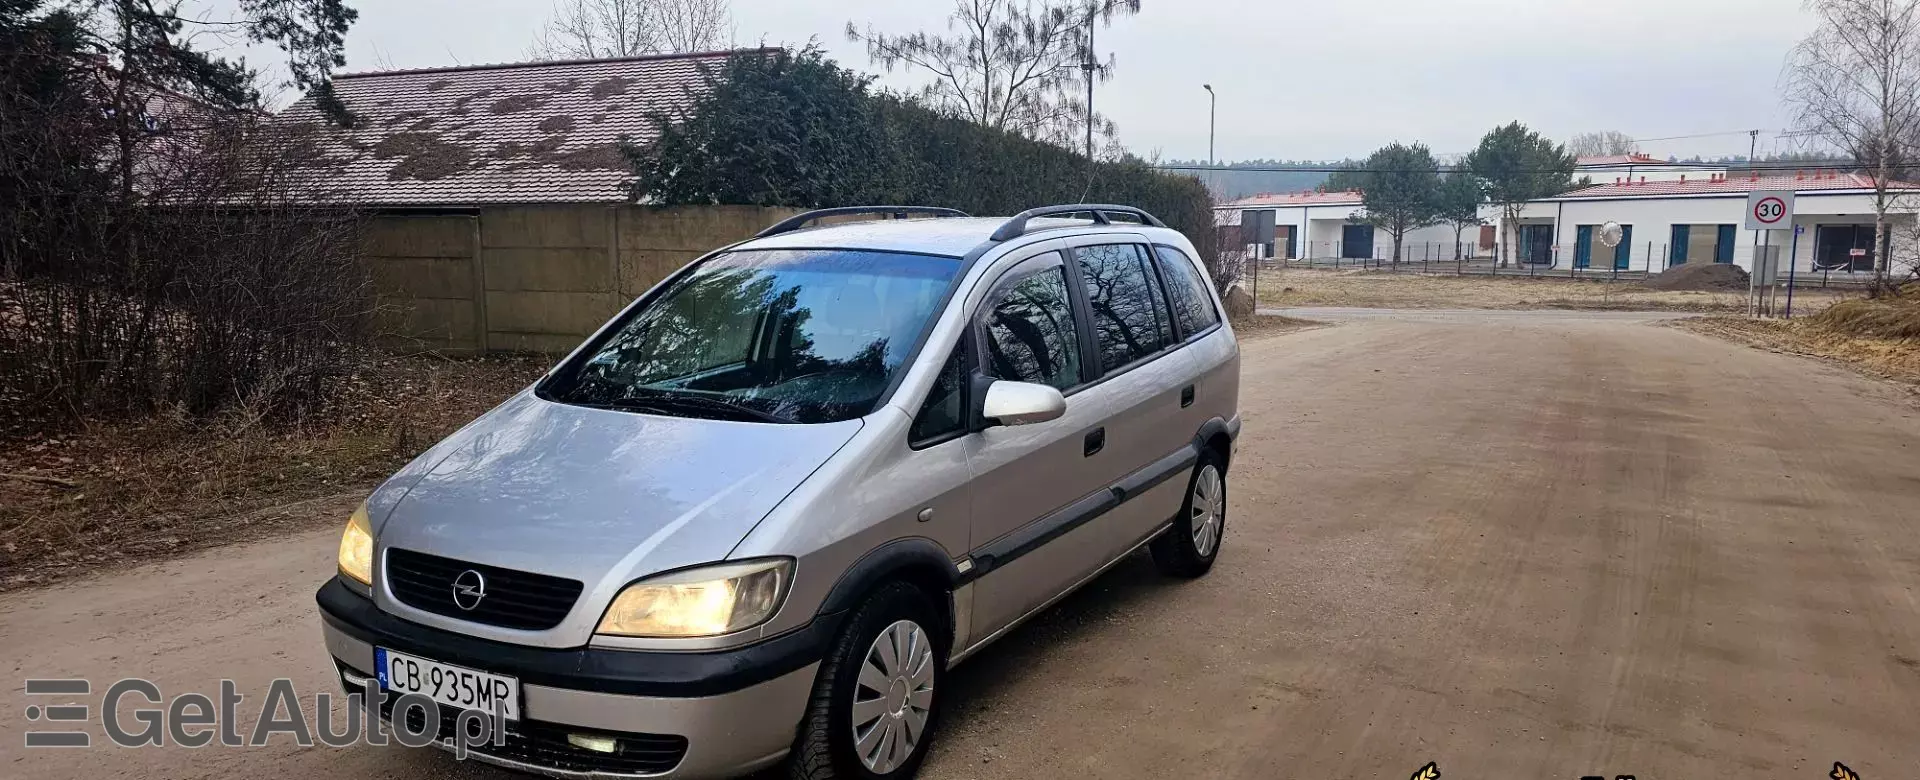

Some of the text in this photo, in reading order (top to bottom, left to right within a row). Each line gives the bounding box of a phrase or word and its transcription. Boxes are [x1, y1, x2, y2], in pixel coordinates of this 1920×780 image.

[1759, 204, 1781, 217] 30
[379, 673, 387, 682] PL
[392, 657, 509, 715] CB 935MR
